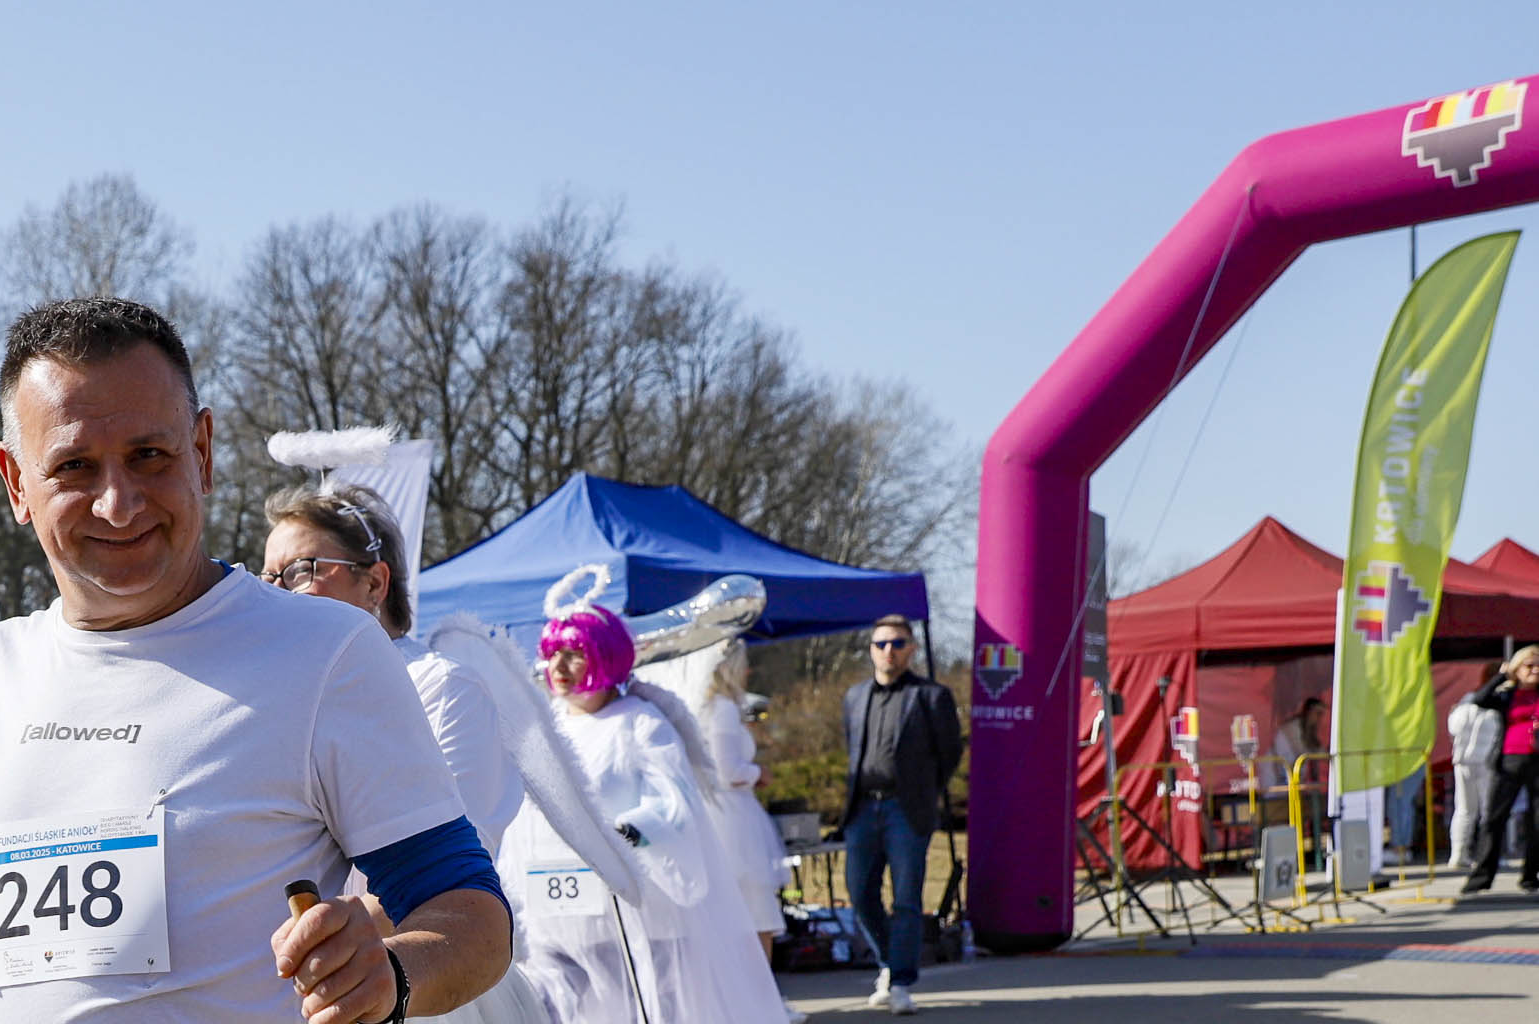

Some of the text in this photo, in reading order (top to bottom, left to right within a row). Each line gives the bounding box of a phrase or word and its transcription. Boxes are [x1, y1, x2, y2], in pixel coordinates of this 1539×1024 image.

[20, 722, 142, 744] [allowed]
[10, 849, 51, 861] 08.03.2025
[56, 842, 102, 855] KATOWICE
[548, 876, 579, 900] 83
